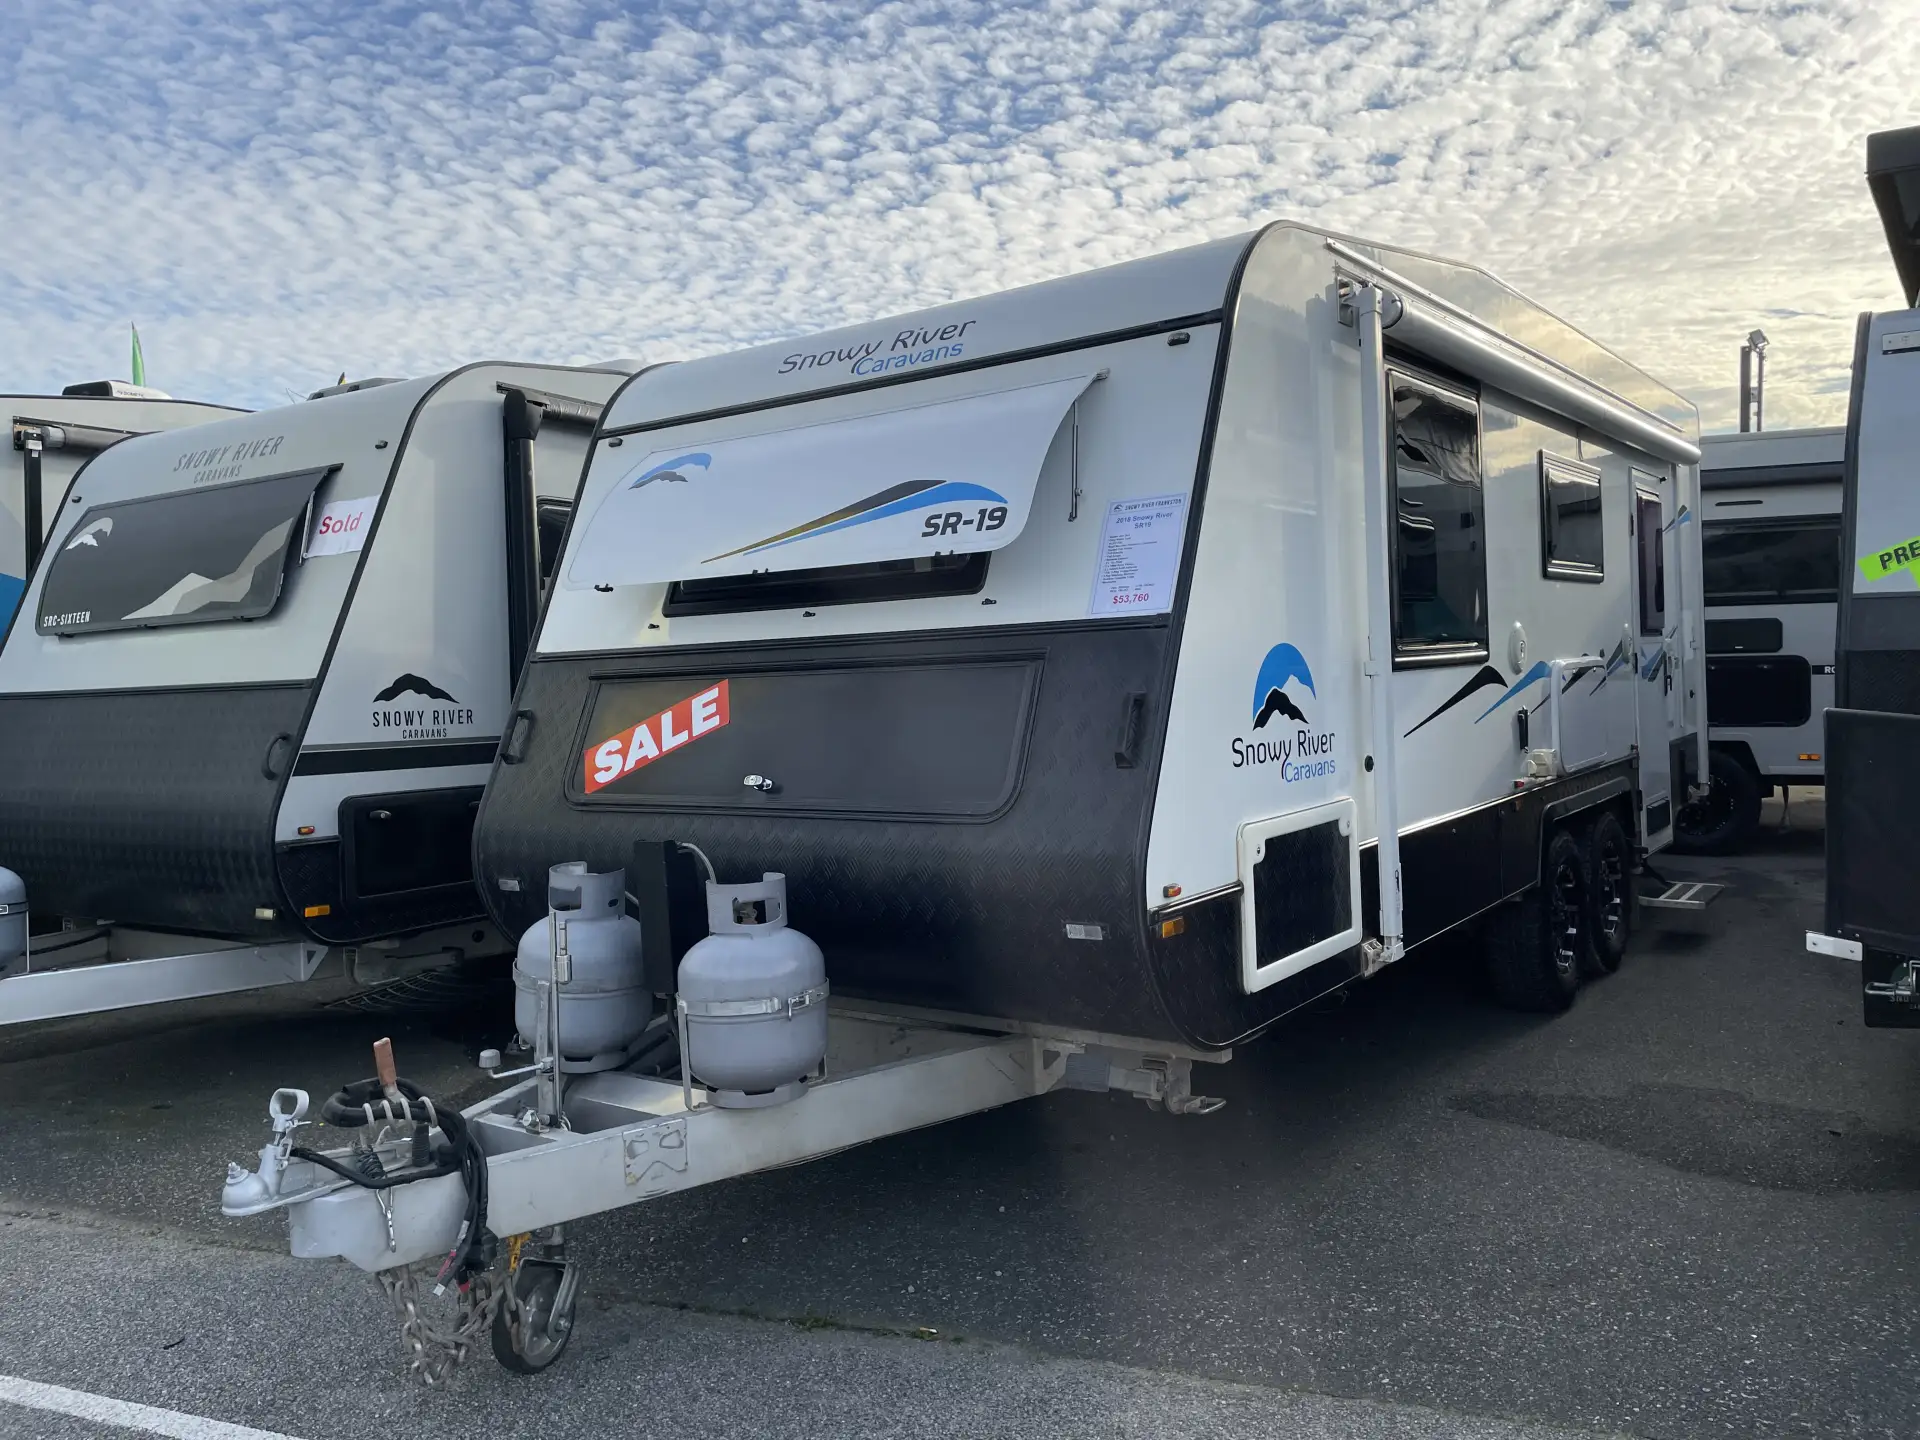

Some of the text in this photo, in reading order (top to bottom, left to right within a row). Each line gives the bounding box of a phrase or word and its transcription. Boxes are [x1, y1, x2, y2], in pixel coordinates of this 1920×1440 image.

[778, 320, 977, 374] Snowy River
[856, 342, 964, 375] Caravans
[173, 435, 285, 472] SNOWY RIVER
[193, 464, 243, 484] CARAVANS
[319, 511, 364, 535] Sold
[921, 506, 1008, 538] SR-19
[1116, 511, 1173, 524] 2018 Snowy River
[1134, 521, 1152, 529] SR19
[1879, 539, 1920, 571] PRE
[1112, 593, 1150, 604] $53,760
[43, 610, 91, 628] SRC-SIXTEEN
[372, 709, 474, 727] SNOWY RIVER
[402, 728, 447, 739] CARAVANS
[593, 687, 720, 784] SALE
[1231, 729, 1336, 779] Snowy River
[1284, 759, 1336, 783] Caravans
